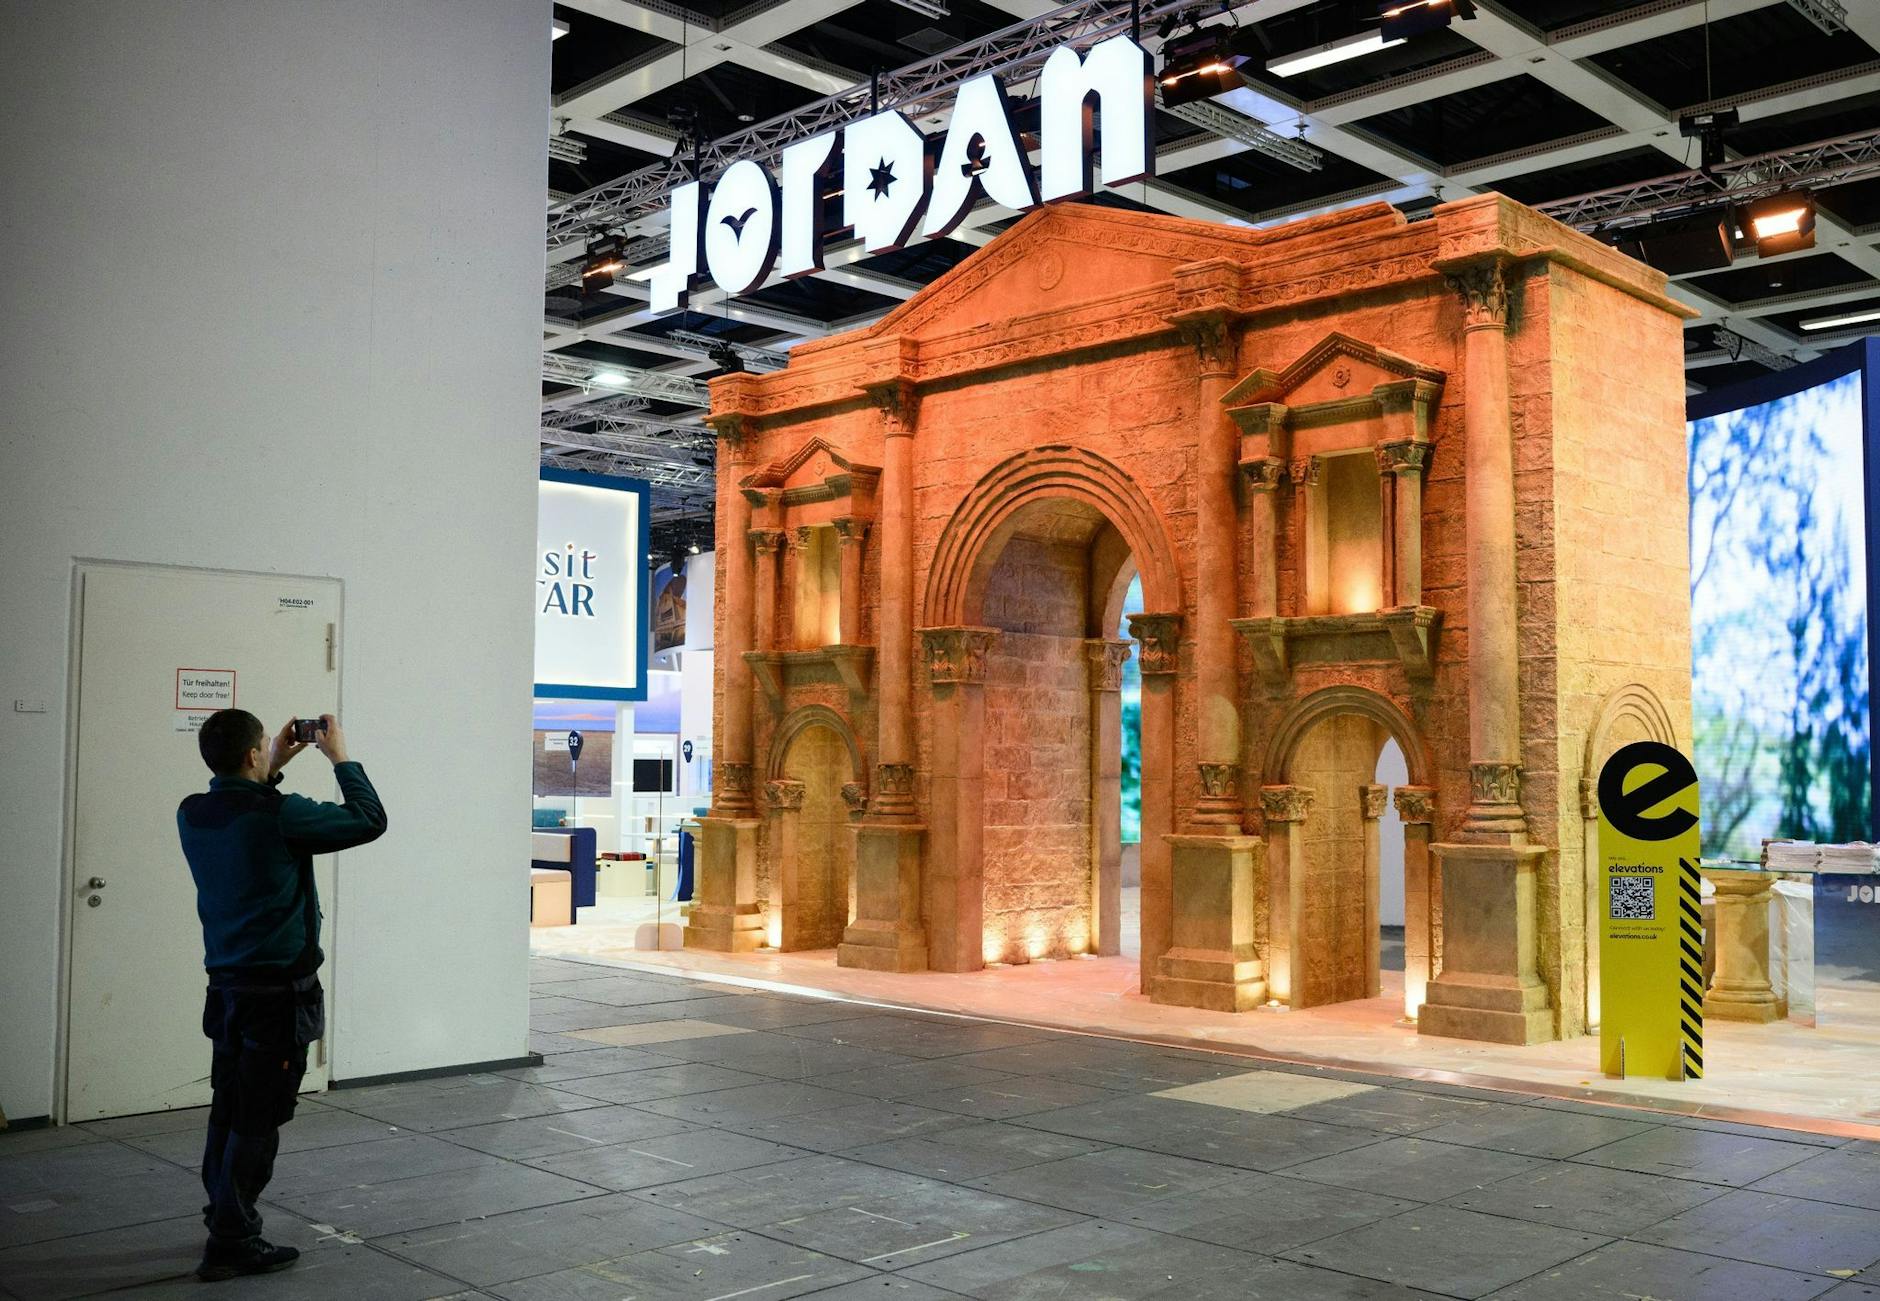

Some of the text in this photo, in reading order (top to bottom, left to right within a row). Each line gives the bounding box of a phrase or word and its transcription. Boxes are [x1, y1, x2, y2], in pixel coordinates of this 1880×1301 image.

[544, 543, 597, 579] sit
[536, 580, 595, 617] AR
[195, 679, 230, 687] freihalten!
[182, 691, 198, 699] Keep
[569, 736, 579, 746] 32
[1608, 862, 1664, 873] elevations
